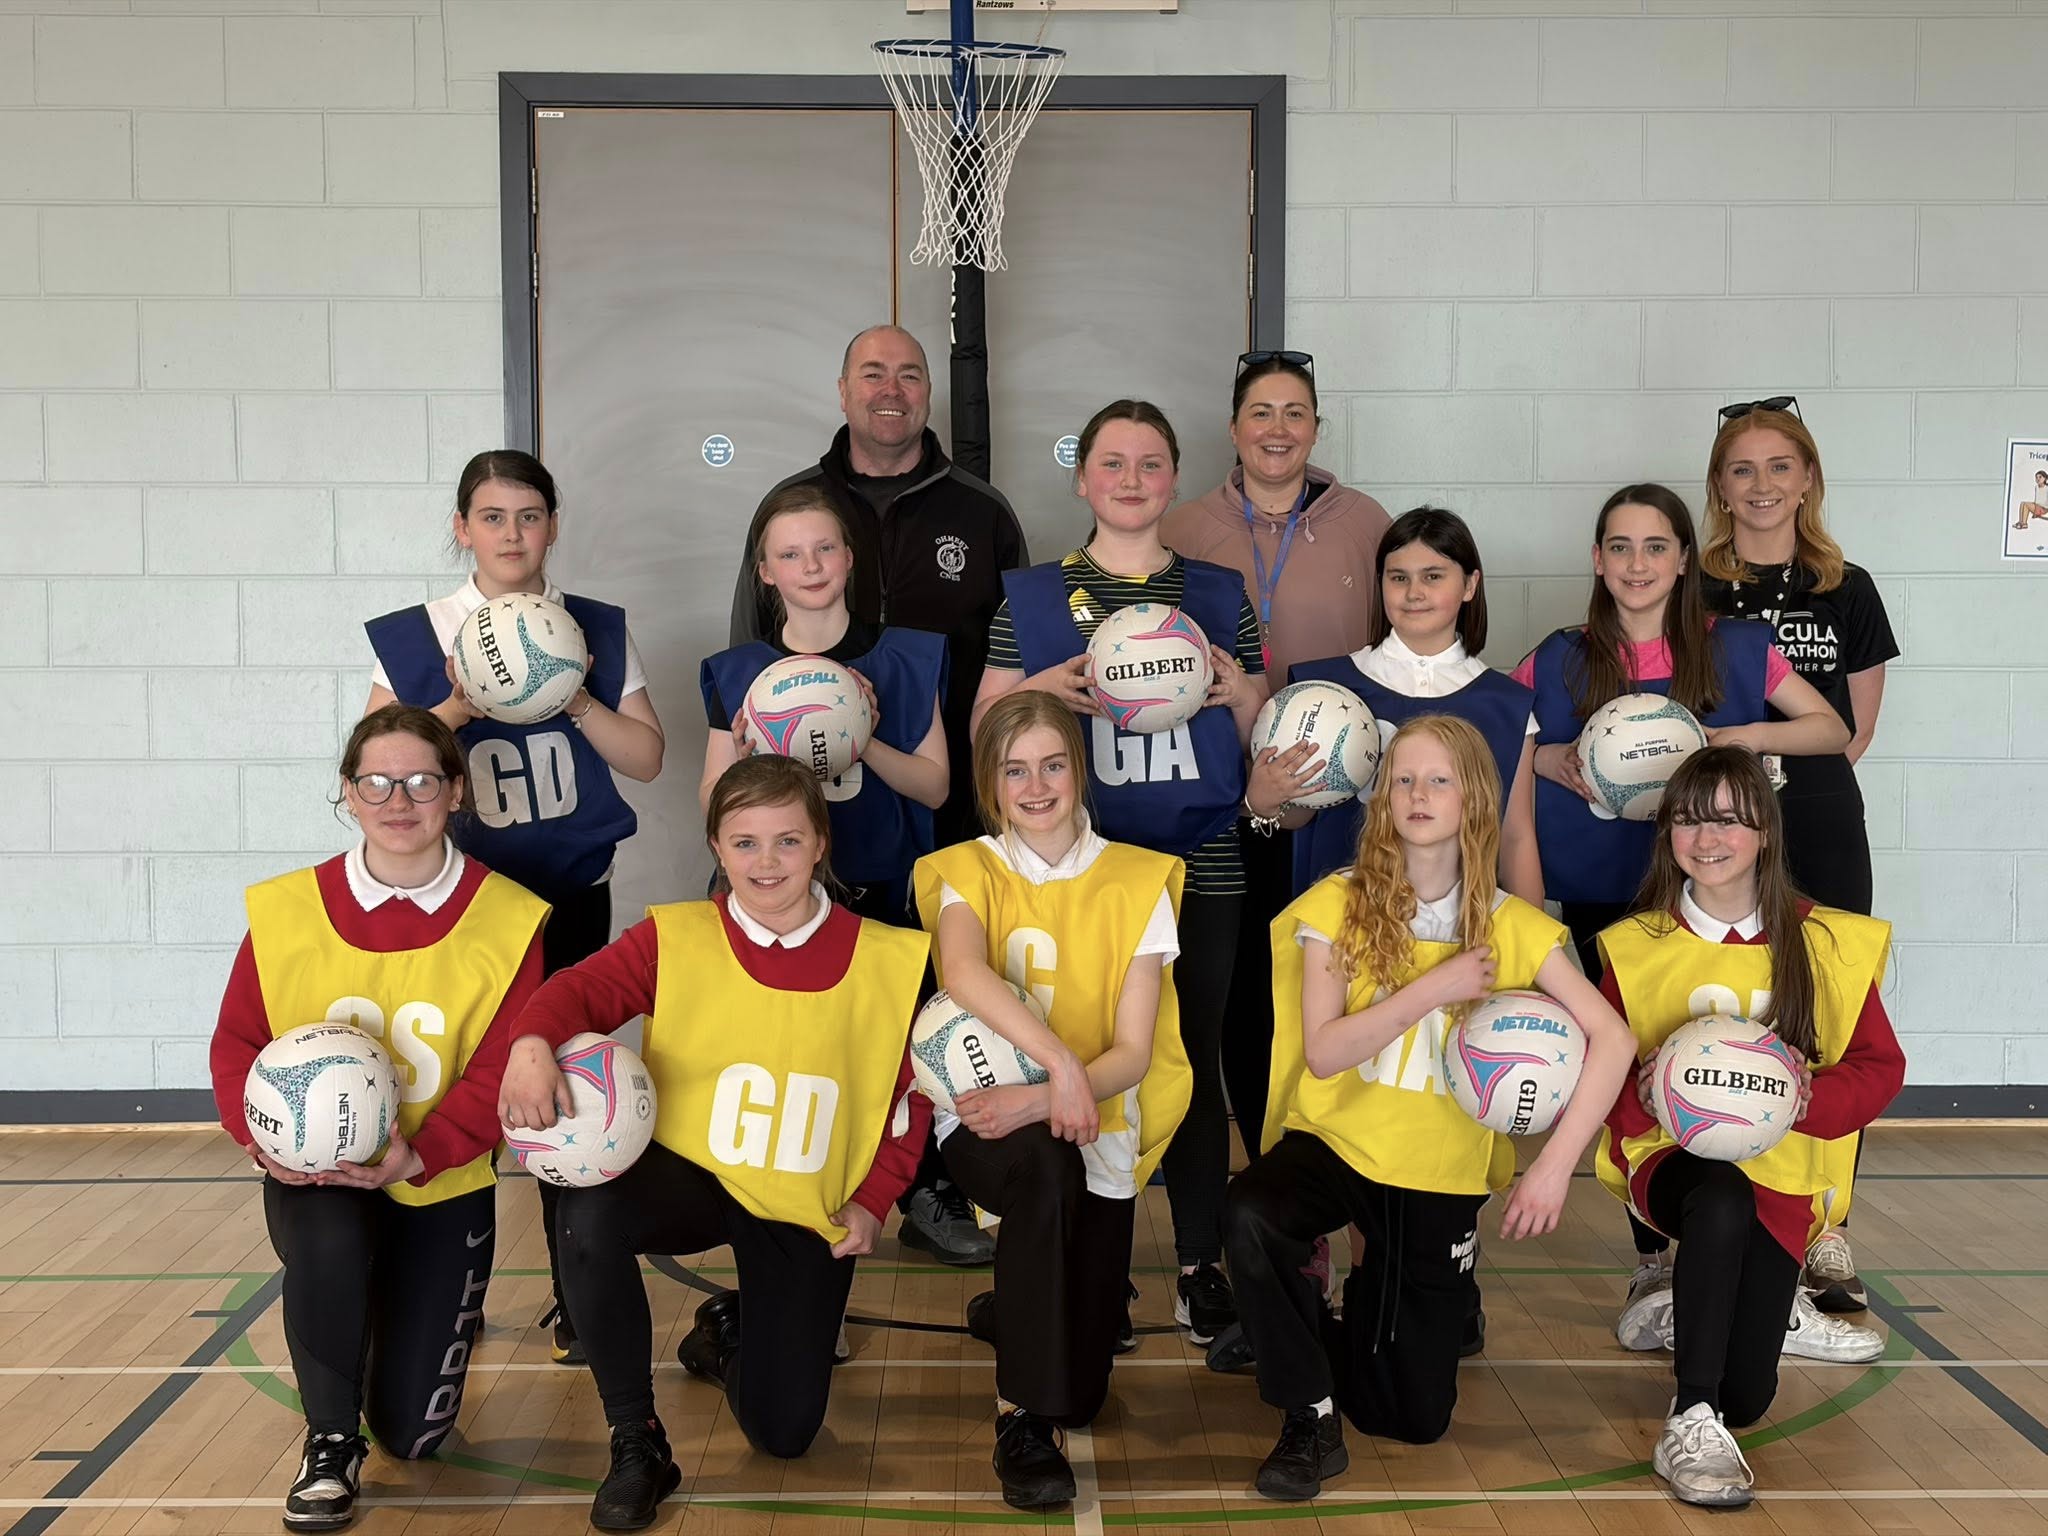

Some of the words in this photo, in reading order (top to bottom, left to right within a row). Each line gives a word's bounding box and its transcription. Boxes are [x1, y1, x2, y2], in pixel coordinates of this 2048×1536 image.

[477, 606, 515, 687] GILBERT
[1775, 644, 1838, 660] RATHON
[1776, 623, 1838, 643] CULA
[772, 671, 839, 696] NETBALL
[1105, 656, 1196, 682] GILBERT
[1795, 662, 1818, 672] HER
[1302, 701, 1323, 741] TBALL
[810, 729, 828, 781] LBERT
[1092, 714, 1200, 786] GA
[1620, 744, 1684, 761] NETBALL
[468, 730, 578, 828] GD
[295, 1028, 370, 1046] NETBALL
[1491, 1015, 1569, 1039] NETBALL
[962, 1034, 997, 1089] GILB
[1684, 1067, 1788, 1097] GILBERT
[244, 1094, 284, 1136] BERT
[334, 1093, 350, 1161] NETBALL
[708, 1062, 839, 1173] GD
[1506, 1079, 1537, 1136] GILBE
